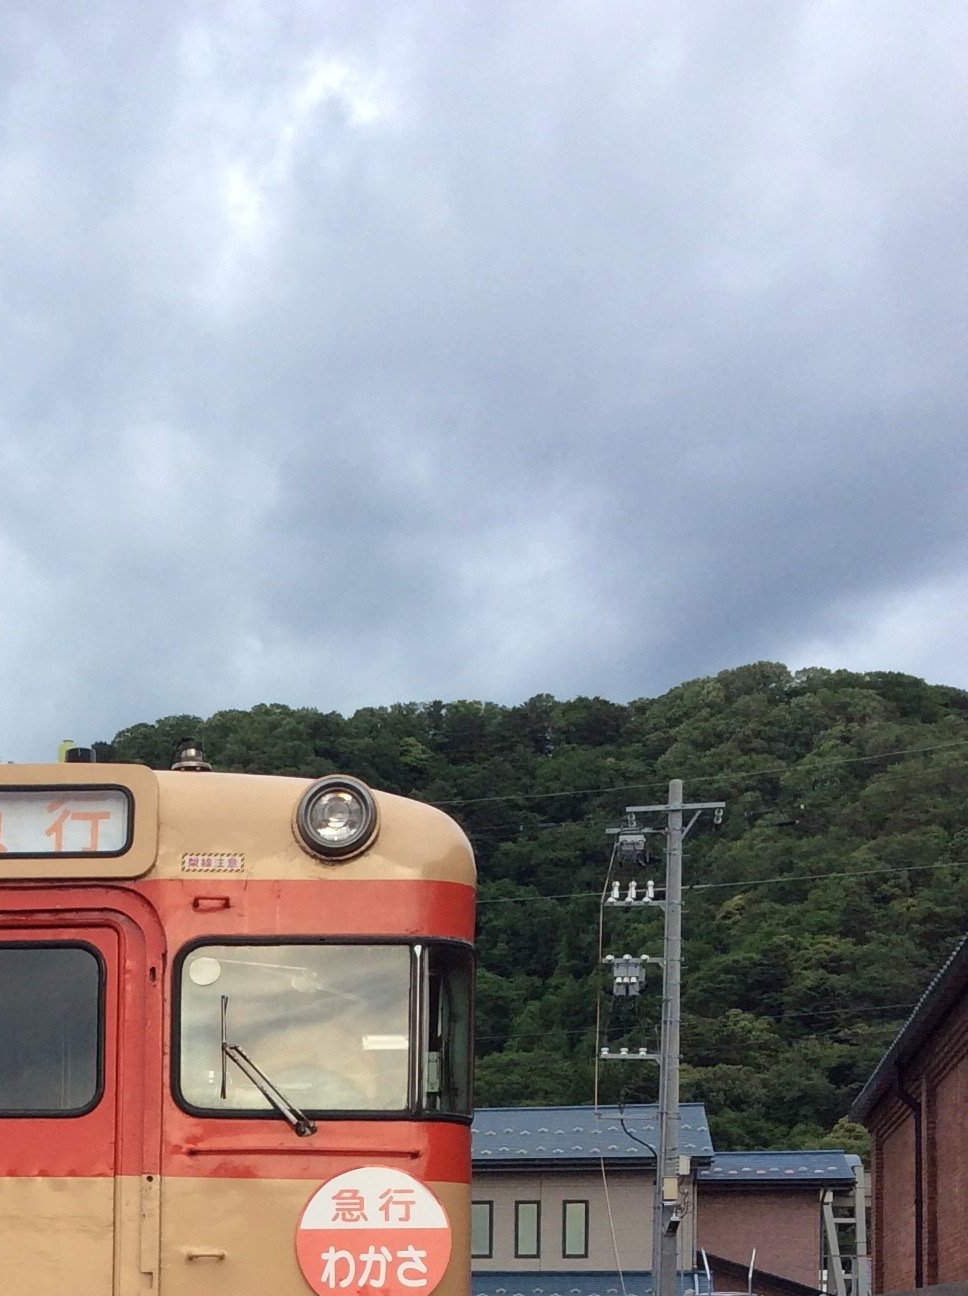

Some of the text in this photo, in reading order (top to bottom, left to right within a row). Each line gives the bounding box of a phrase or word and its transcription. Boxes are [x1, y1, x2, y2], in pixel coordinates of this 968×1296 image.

[331, 1188, 416, 1222] 急行
[320, 1245, 428, 1289] わかさ
